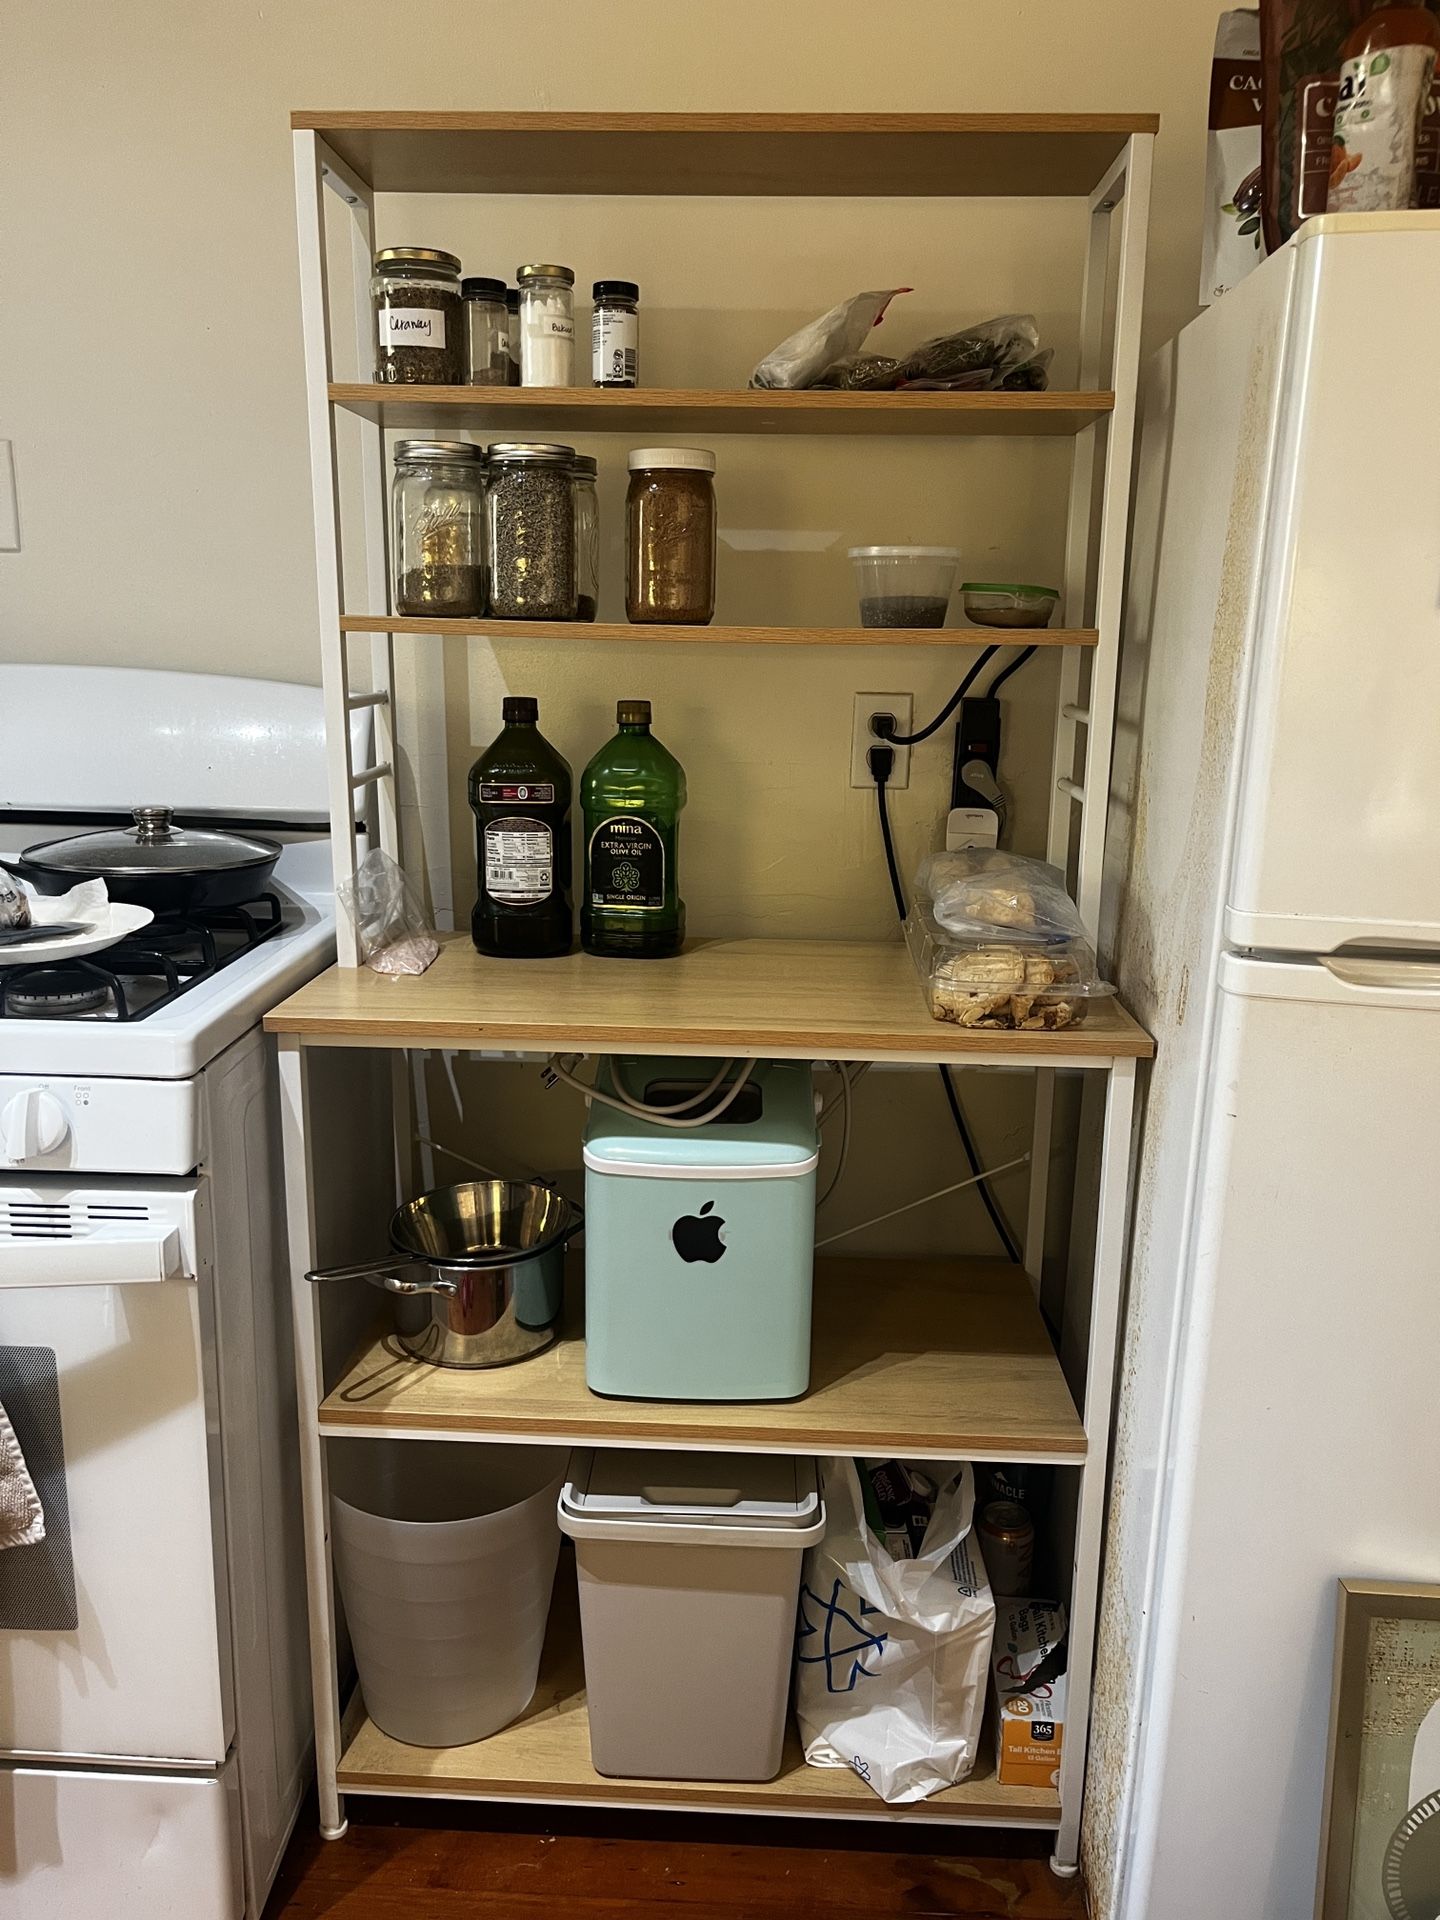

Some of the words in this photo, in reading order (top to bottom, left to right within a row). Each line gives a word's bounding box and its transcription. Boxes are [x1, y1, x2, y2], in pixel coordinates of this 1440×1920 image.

[610, 822, 642, 834] mina
[600, 841, 625, 849] EXTRA
[626, 842, 652, 850] VIRGIN
[1016, 1700, 1029, 1713] 20
[1032, 1724, 1053, 1736] 365
